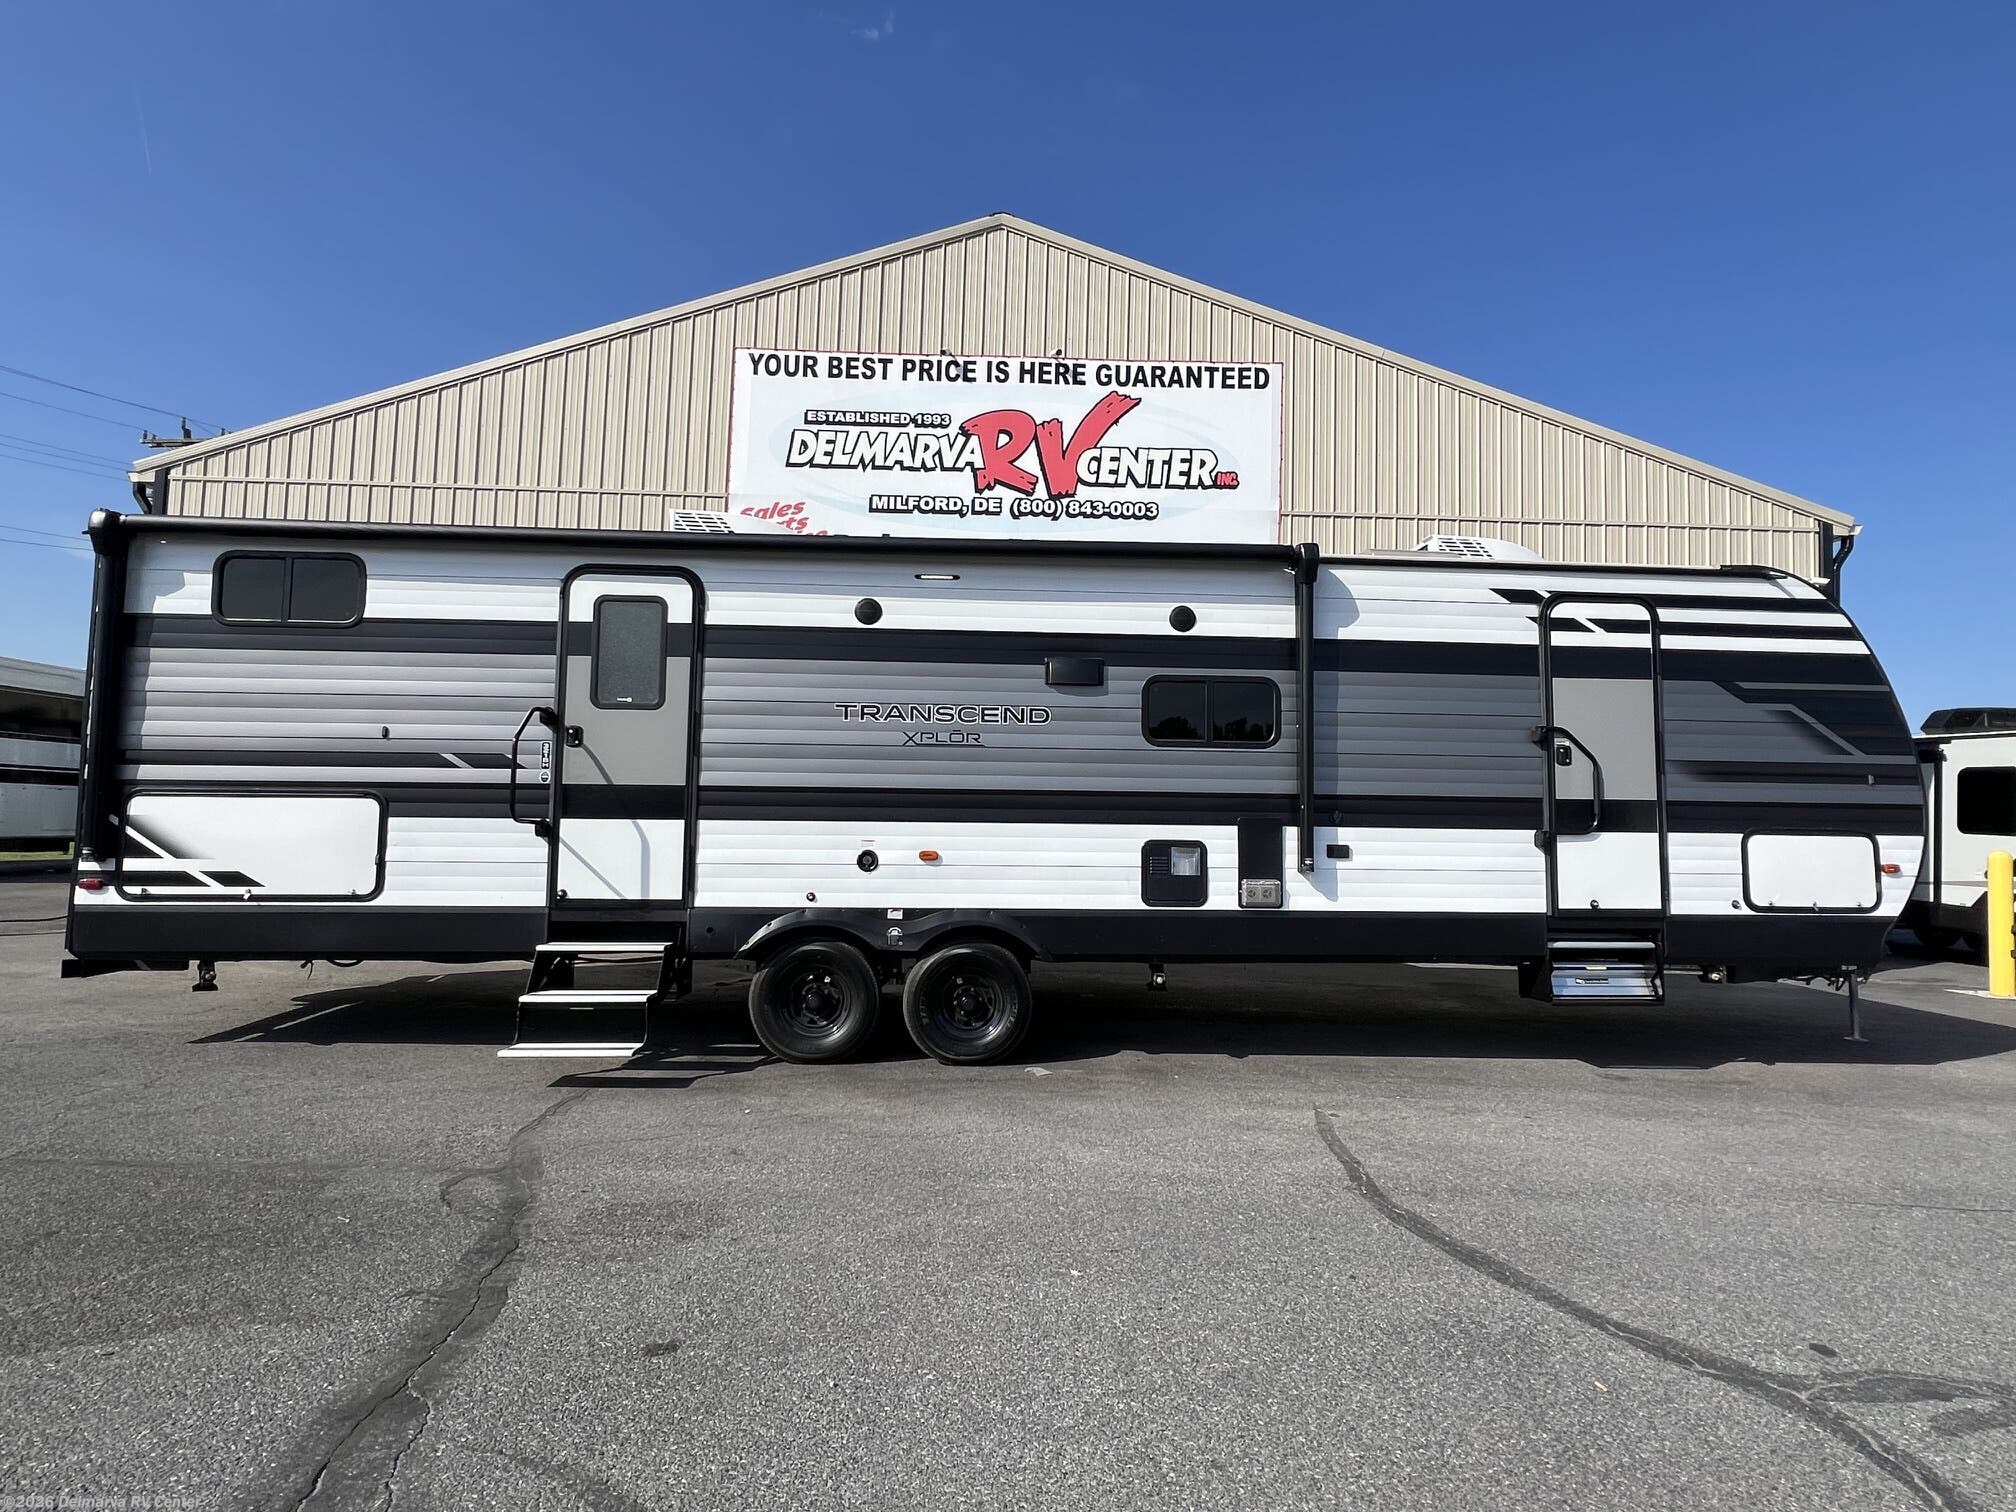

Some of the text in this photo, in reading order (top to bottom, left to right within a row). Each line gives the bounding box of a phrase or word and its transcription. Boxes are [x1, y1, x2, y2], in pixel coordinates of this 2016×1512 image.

[749, 352, 1270, 390] YOUR BEST PRICE IS HERE GUARANTEED
[805, 410, 951, 429] ESTABLISHED 1993
[786, 391, 1240, 499] DELMARVA RV CENTER INC.
[869, 494, 1159, 521] MILFORD, DE (800) 843-0003
[834, 703, 1052, 726] TRANSCEND
